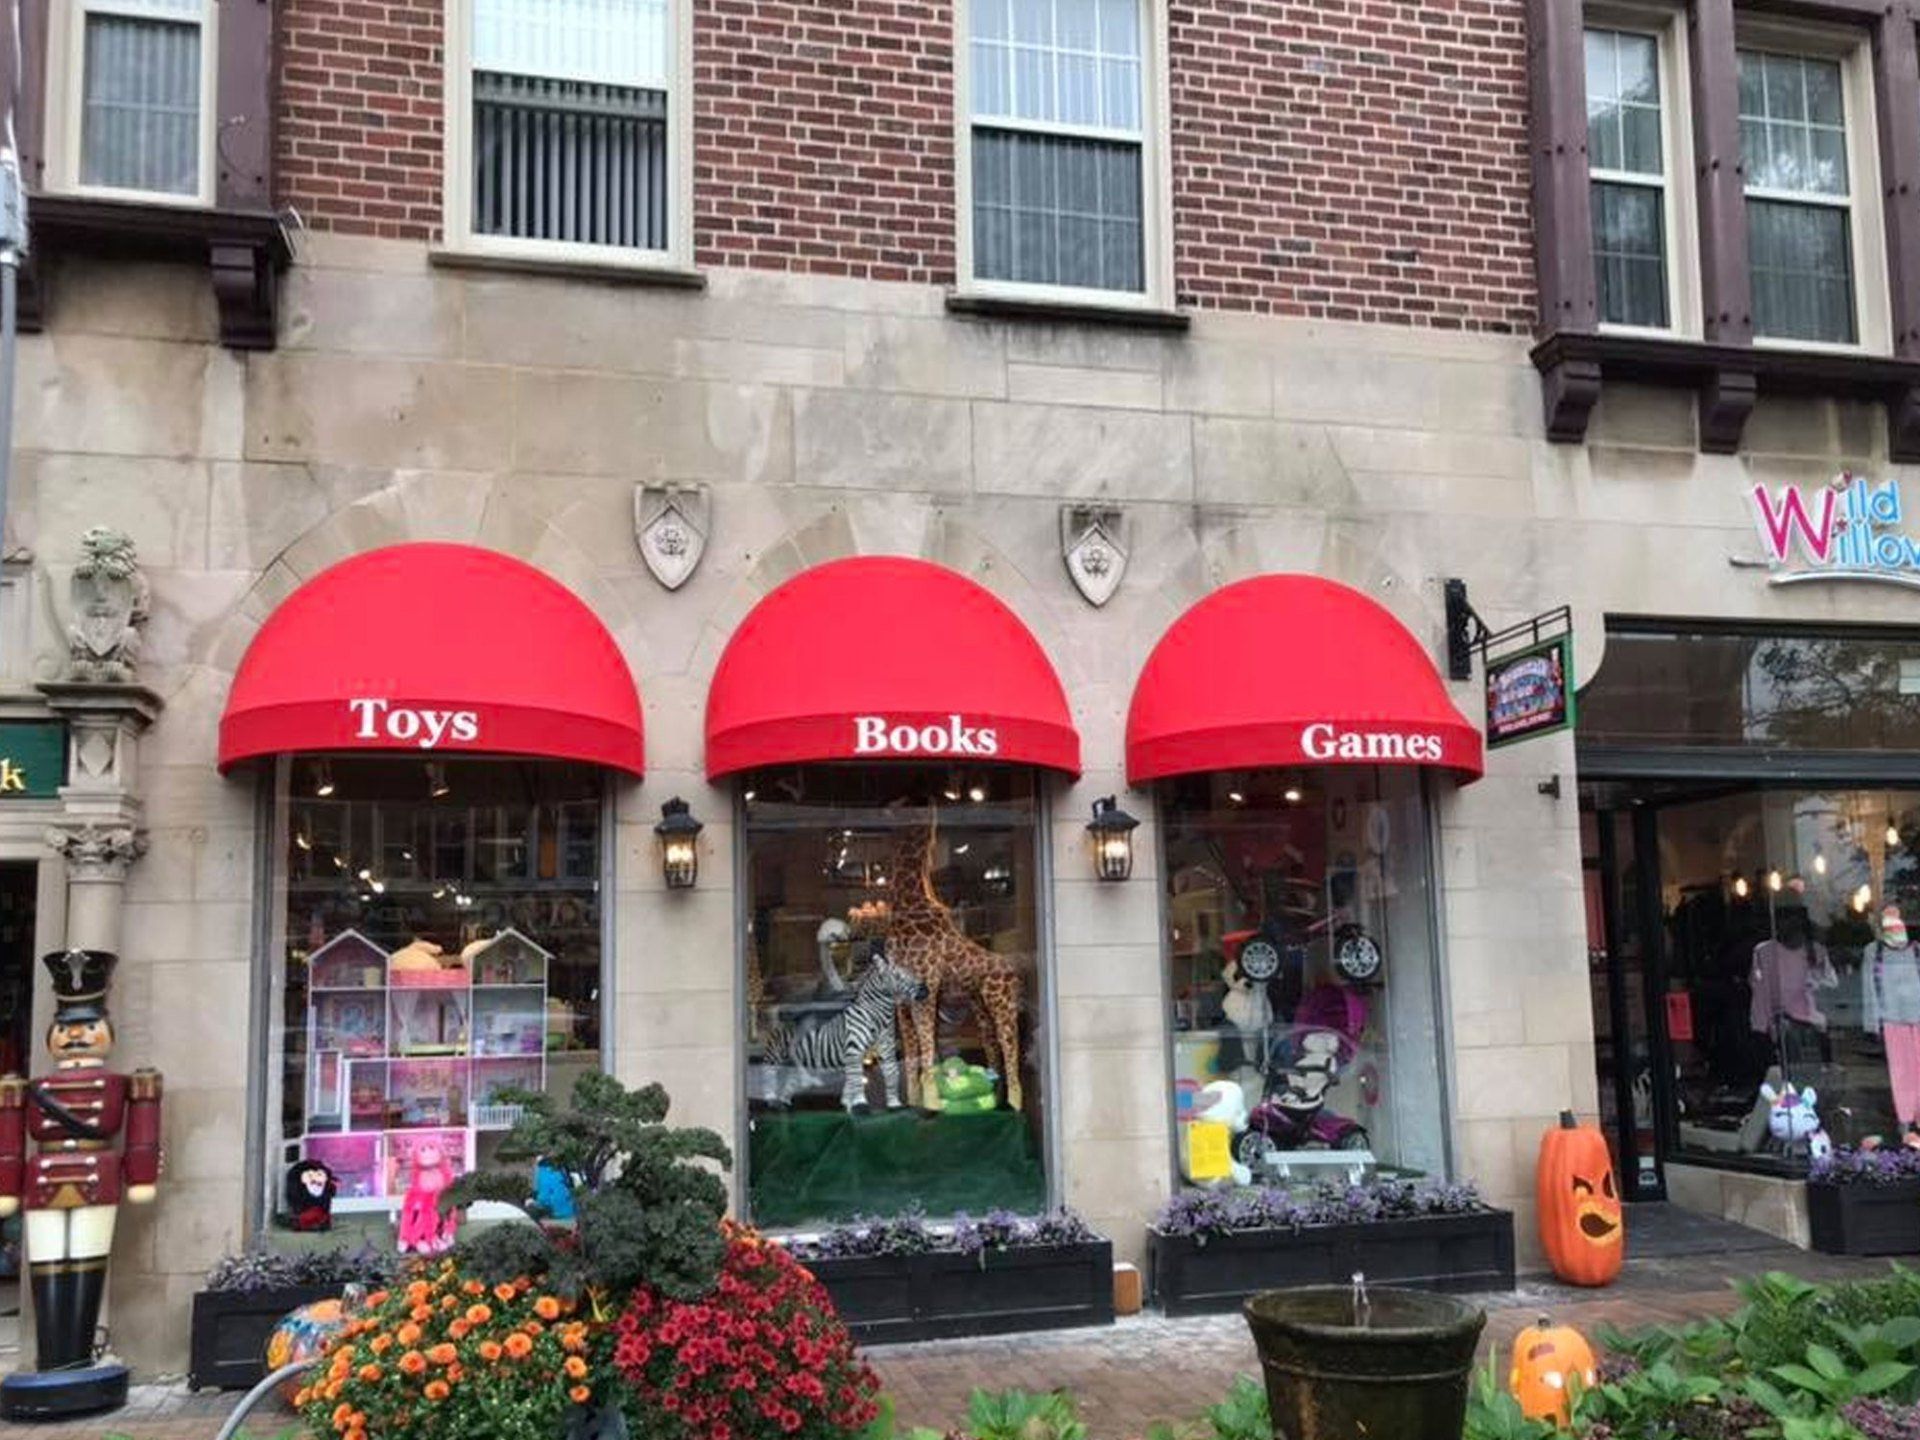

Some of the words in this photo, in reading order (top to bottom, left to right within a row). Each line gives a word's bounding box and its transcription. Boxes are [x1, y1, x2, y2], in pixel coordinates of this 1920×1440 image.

[350, 698, 478, 748] Toys
[854, 714, 998, 755] Books
[1301, 723, 1443, 760] Games
